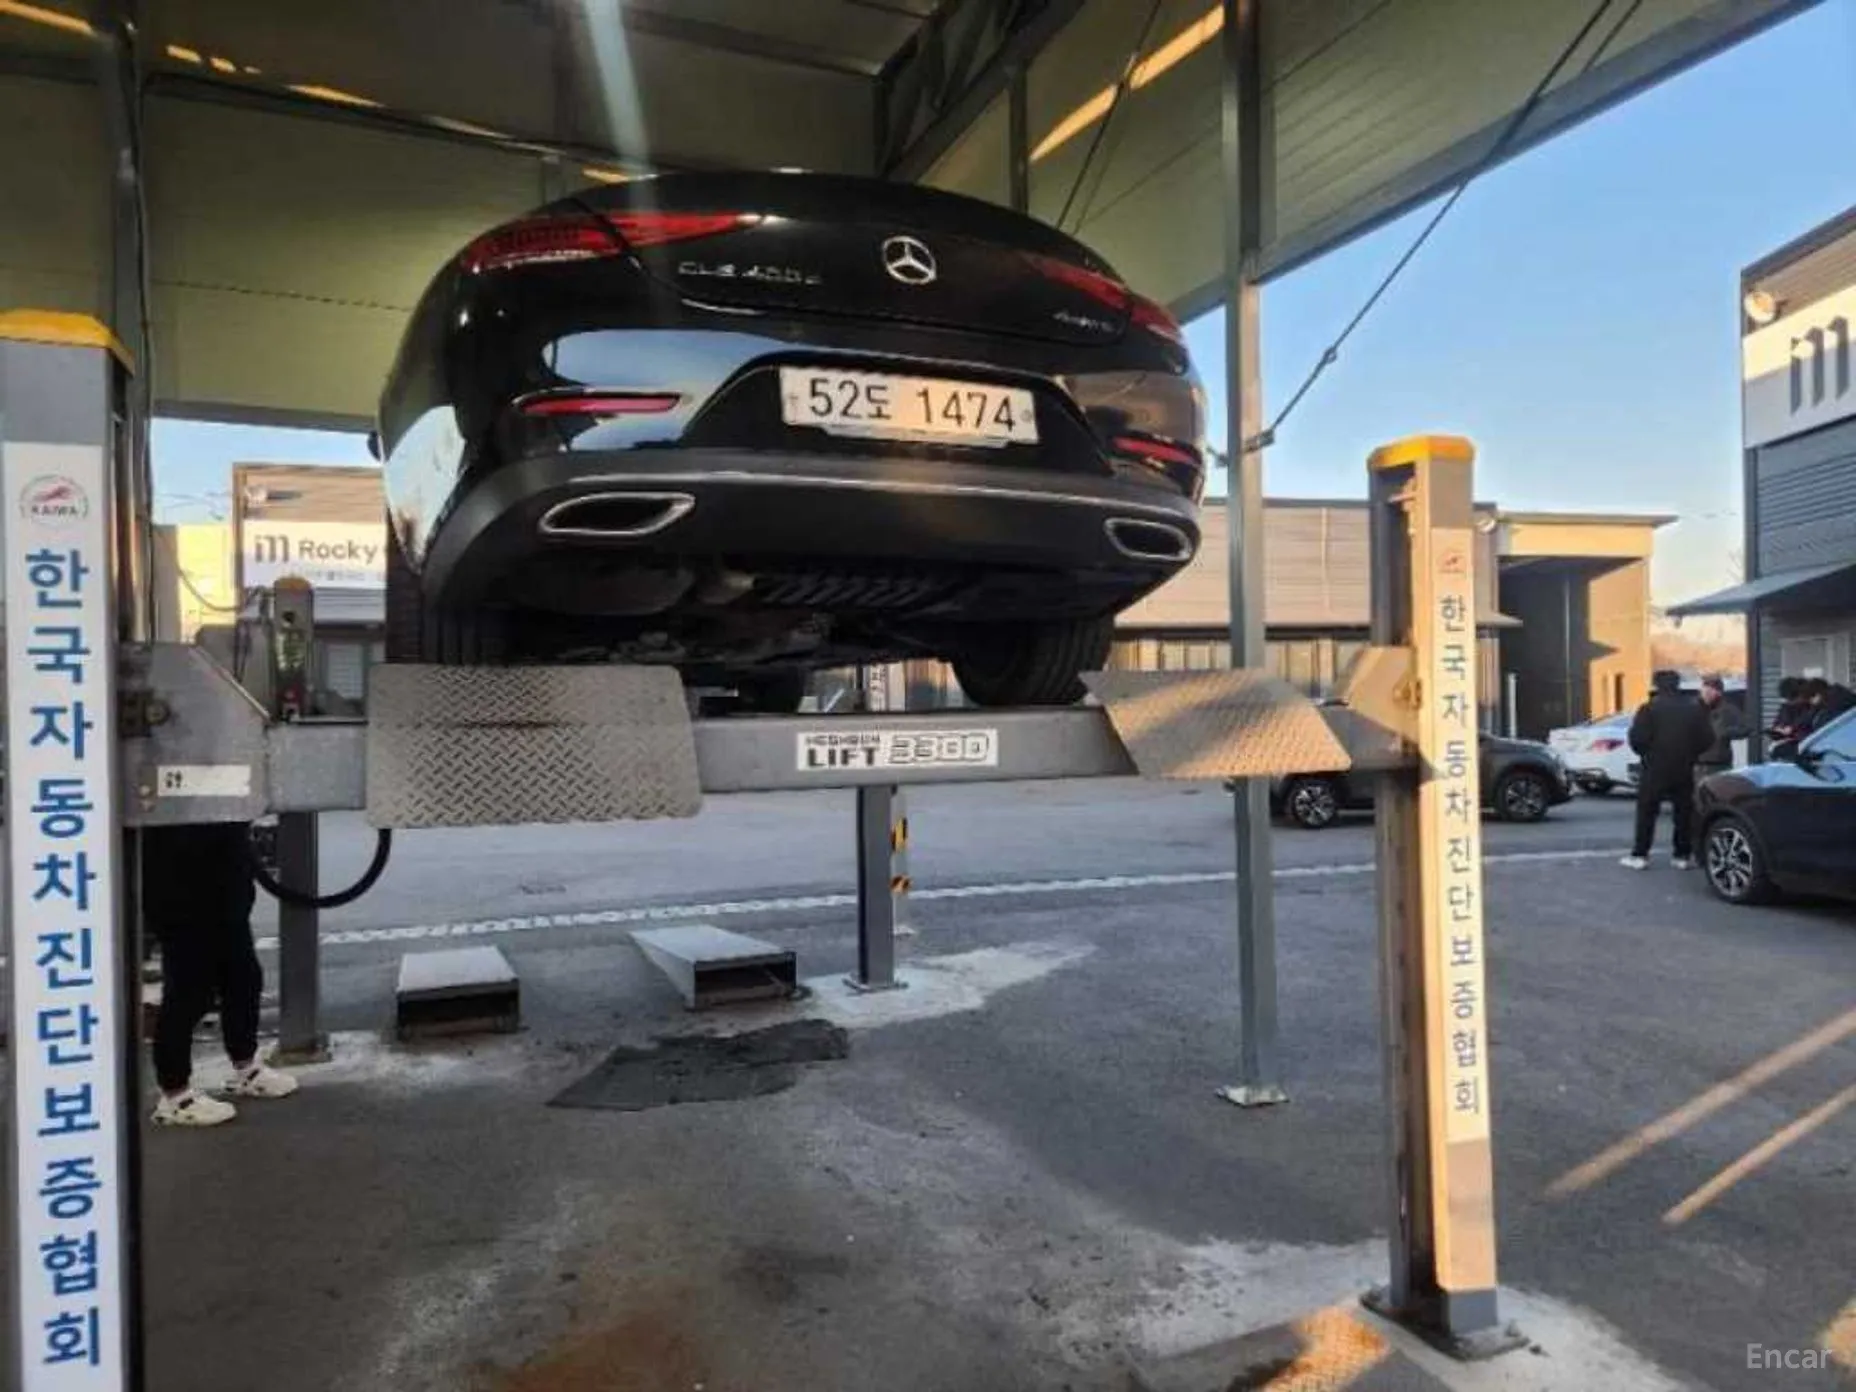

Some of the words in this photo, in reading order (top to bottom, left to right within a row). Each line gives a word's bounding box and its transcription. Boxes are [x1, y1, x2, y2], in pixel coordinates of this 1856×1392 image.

[809, 377, 892, 421] 52도
[916, 386, 1017, 432] 1474
[298, 537, 378, 565] Rocky
[808, 746, 877, 767] LIFT
[25, 548, 102, 1368] 한국자동차진단보증협회
